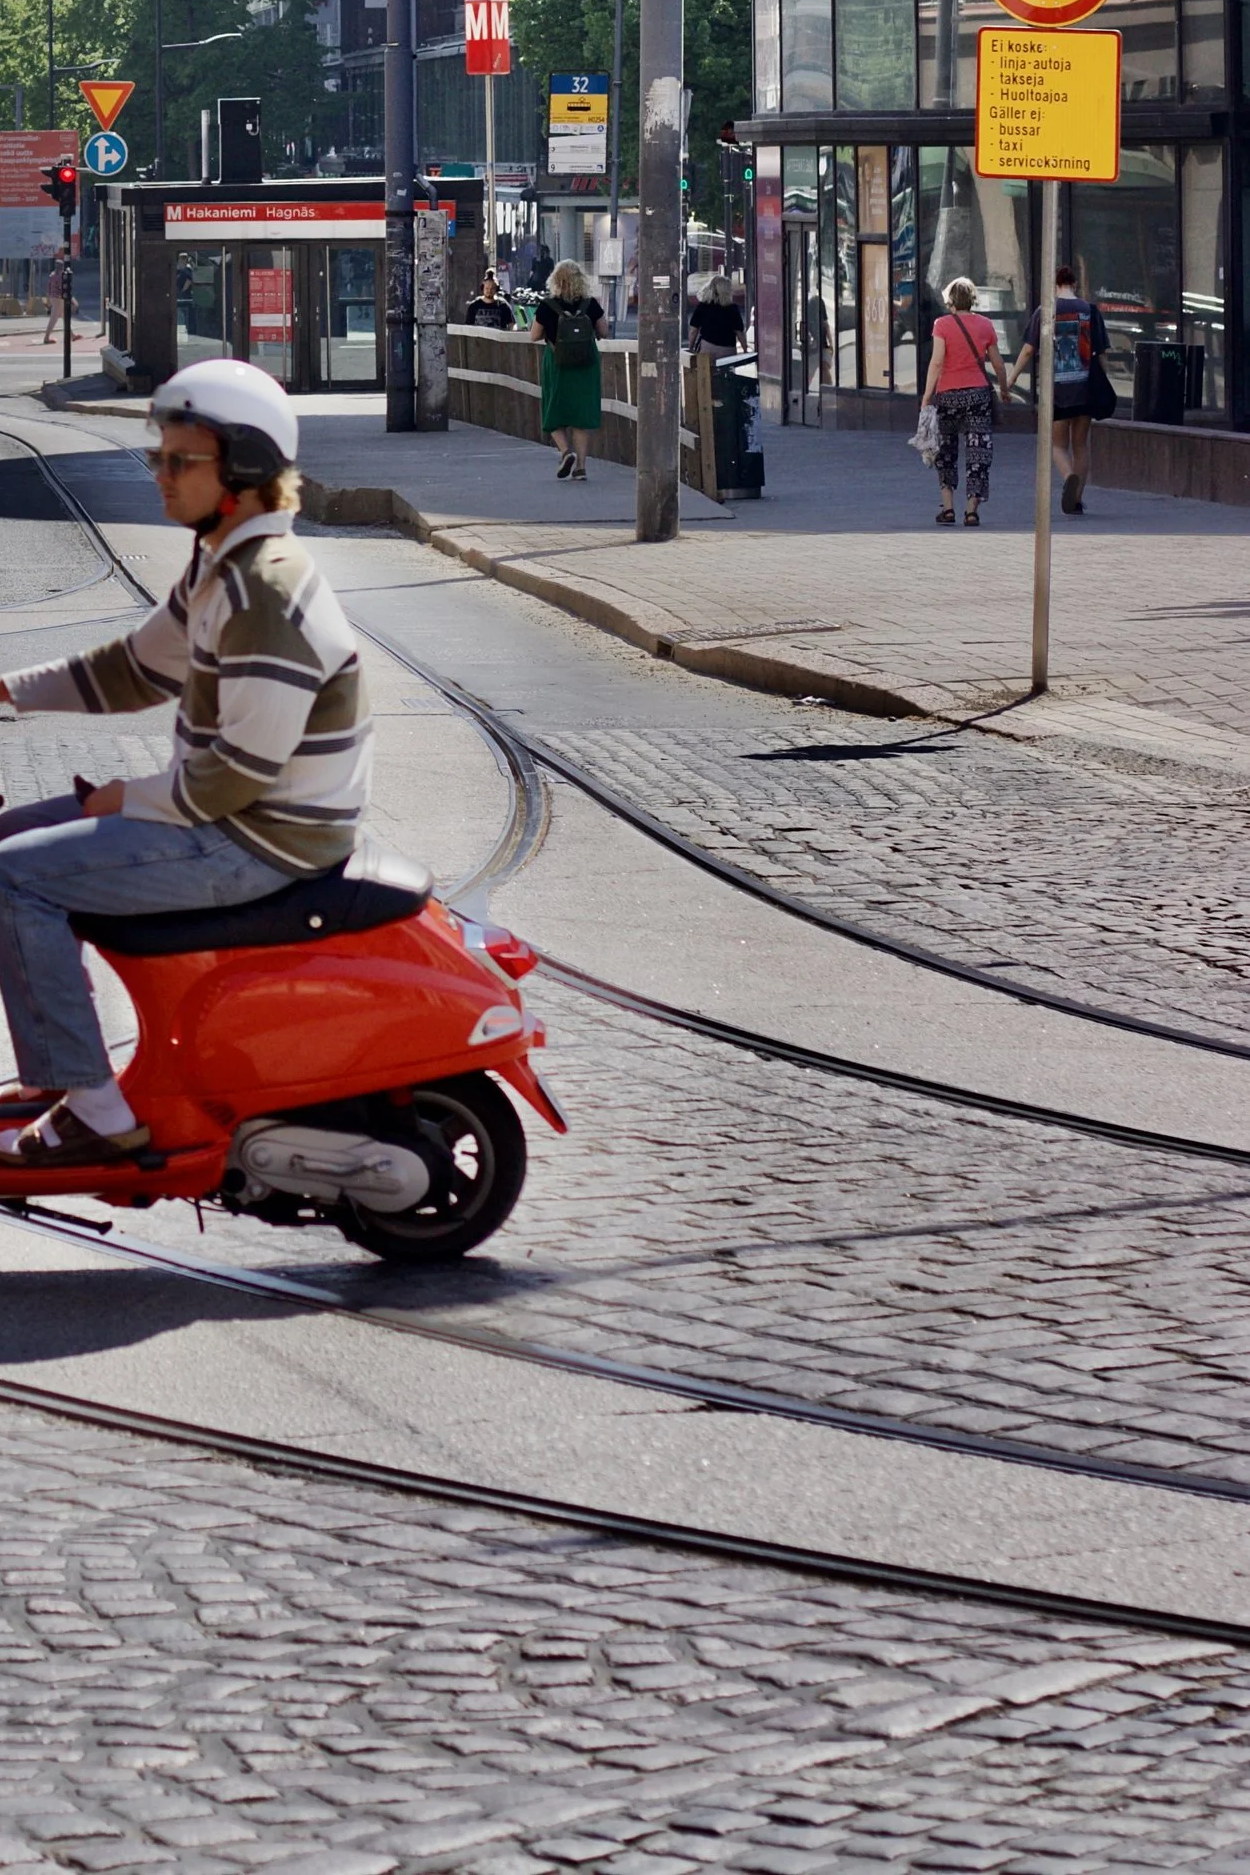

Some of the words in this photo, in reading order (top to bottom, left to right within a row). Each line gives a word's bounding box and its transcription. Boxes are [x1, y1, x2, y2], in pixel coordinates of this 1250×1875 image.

[465, 2, 488, 40] M
[491, 2, 509, 40] M
[991, 39, 1003, 53] Ei
[1000, 56, 1071, 73] linja-autoja
[572, 76, 589, 93] 32
[1000, 73, 1044, 87] takseja
[1000, 88, 1068, 104] Huoltoajoa
[989, 106, 1026, 120] Gäller
[1030, 110, 1046, 122] ej:
[999, 123, 1040, 136] bussar
[999, 138, 1023, 151] taxi
[551, 164, 556, 172] 9
[999, 155, 1091, 172] servicekörning
[166, 205, 182, 220] M
[186, 206, 257, 219] Hakaniemi
[266, 206, 315, 221] Hagnäs
